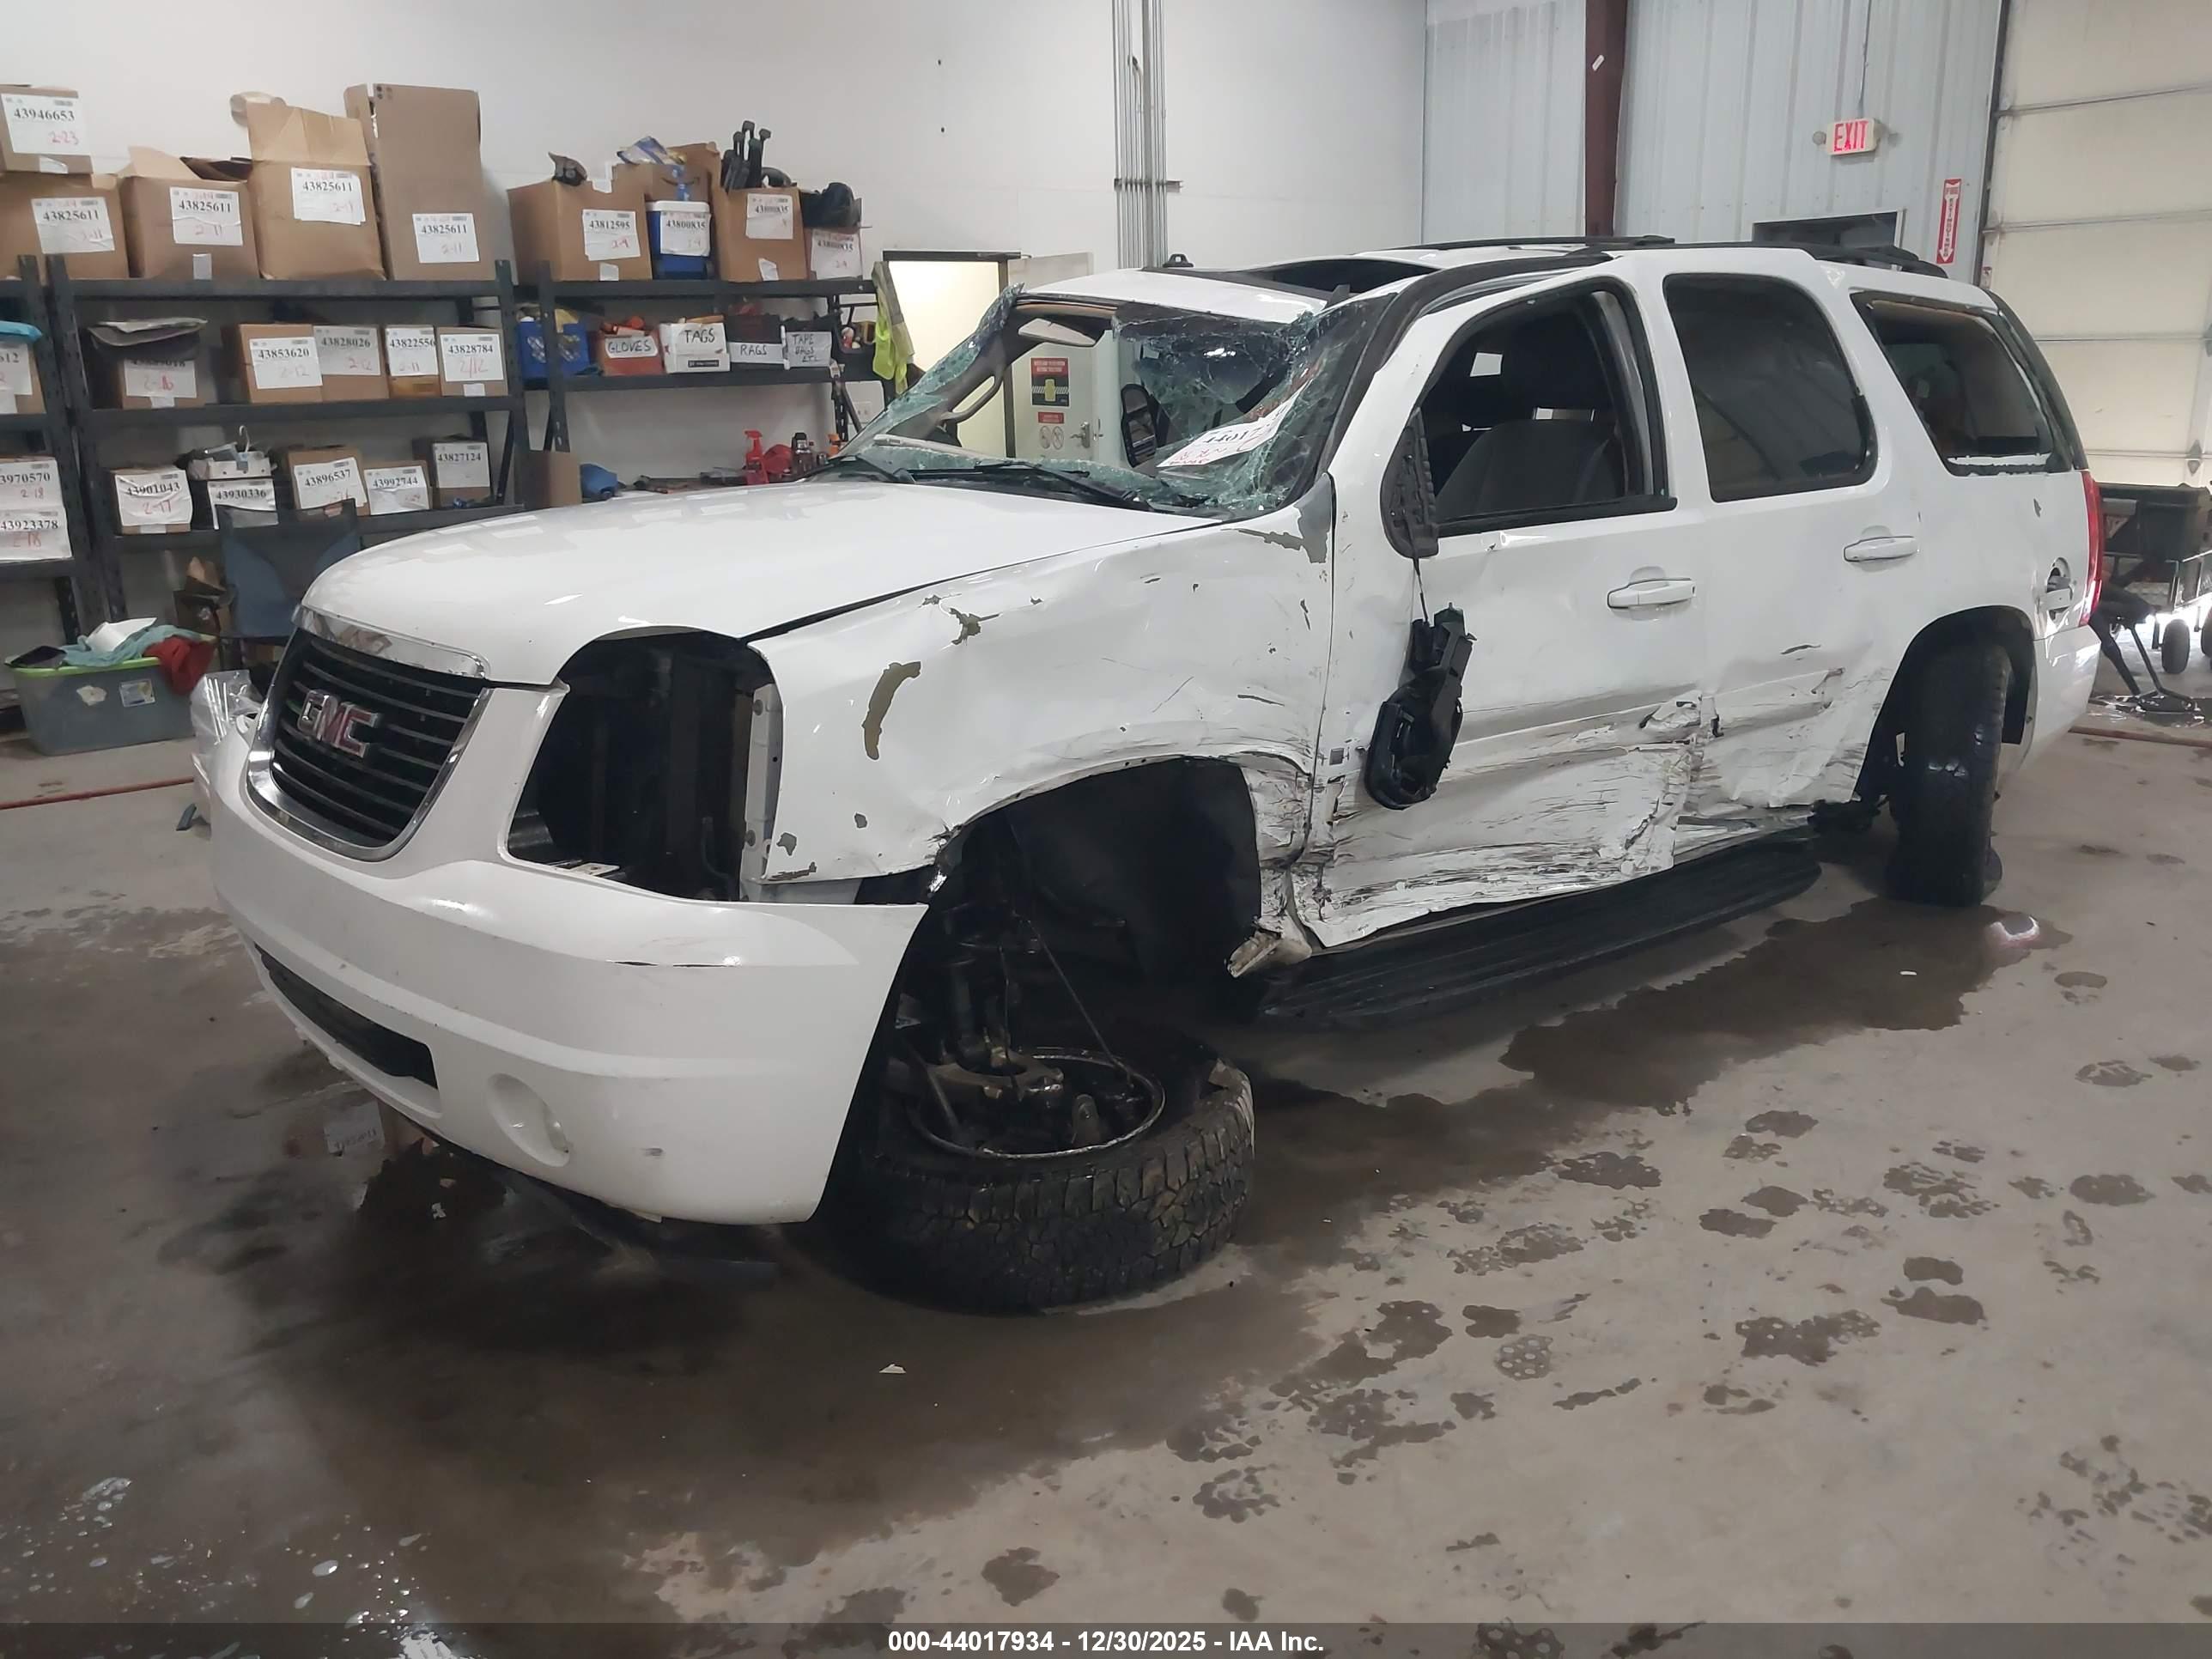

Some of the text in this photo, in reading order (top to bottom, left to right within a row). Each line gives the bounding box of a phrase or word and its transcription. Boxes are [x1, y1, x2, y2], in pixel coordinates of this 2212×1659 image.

[14, 108, 75, 121] 43946653
[1833, 120, 1869, 152] EXIT
[302, 181, 353, 191] 43825611
[178, 200, 231, 213] 43825611
[43, 210, 99, 222] 43825611
[421, 224, 468, 234] 43825611
[684, 327, 715, 343] TAGS
[448, 344, 493, 354] 43828784
[607, 339, 652, 354] GLOVES
[740, 344, 768, 356] RAGS
[258, 348, 310, 359] 43853620
[0, 520, 58, 530] 43923378
[297, 689, 379, 758] GMC
